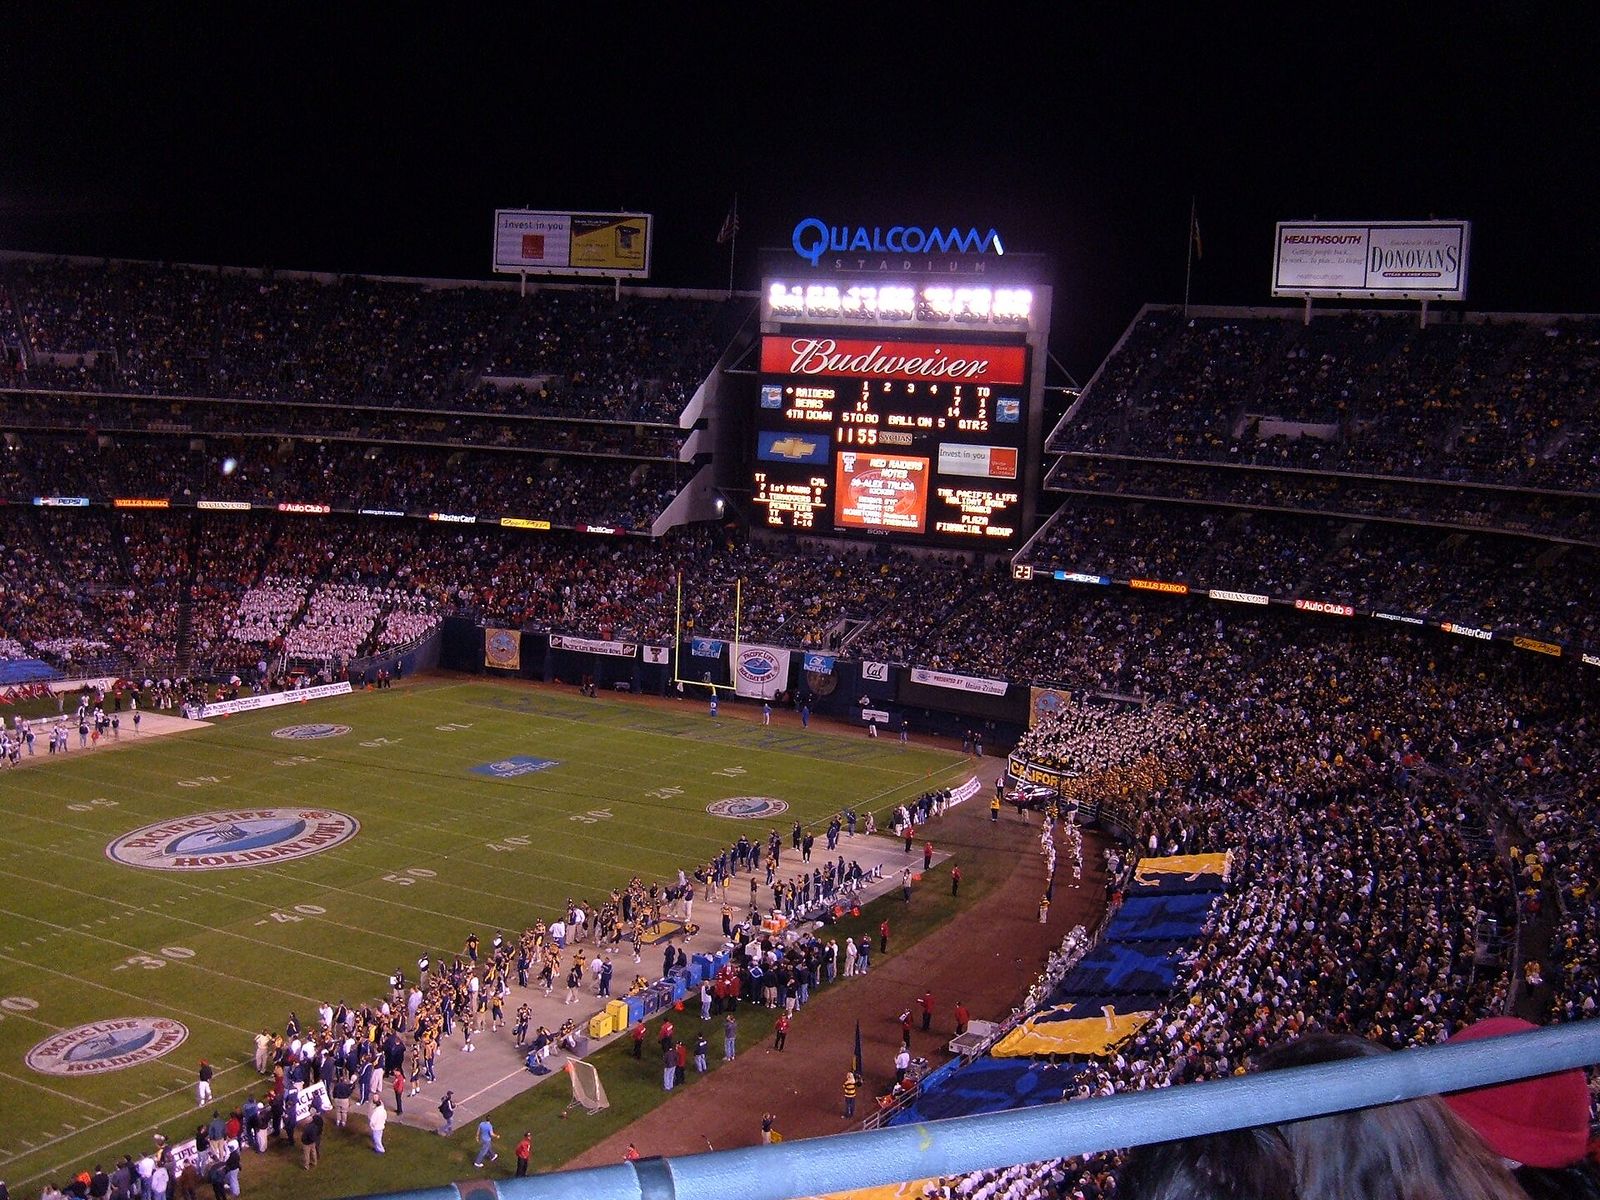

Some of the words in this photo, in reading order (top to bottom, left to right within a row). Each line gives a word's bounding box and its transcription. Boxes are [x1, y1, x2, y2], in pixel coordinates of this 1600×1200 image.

[504, 220, 532, 228] Invest
[536, 221, 544, 229] in
[548, 223, 563, 231] you
[792, 217, 1004, 267] QUALCOMM
[1284, 235, 1362, 245] HEALTHSOUTH
[835, 259, 985, 271] STADIUM
[1371, 244, 1457, 273] DONOVAN'S
[790, 339, 988, 378] Budweiser
[862, 381, 869, 391] 1
[884, 382, 892, 392] 2
[907, 383, 915, 393] 3
[930, 384, 938, 394] 4
[955, 386, 962, 395] T
[977, 387, 991, 397] TO
[796, 388, 835, 399] RAIDERS
[862, 391, 870, 401] 7
[953, 396, 961, 406] 7
[980, 398, 986, 408] 1
[856, 401, 868, 412] 14
[947, 407, 960, 417] 14
[978, 409, 987, 419] 2
[786, 409, 804, 419] 4TH
[806, 410, 833, 421] DOWN
[888, 415, 915, 426] BALL
[937, 418, 946, 428] 5
[940, 448, 961, 458] Invest
[963, 451, 971, 459] in
[973, 452, 986, 461] you
[956, 489, 993, 500] PACIFIC
[996, 493, 1018, 502] LIFE
[287, 504, 304, 512] Auto
[305, 505, 323, 513] Club
[1015, 566, 1031, 578] 23
[1074, 575, 1100, 584] PEPSI
[1131, 579, 1160, 589] WELLS
[1160, 583, 1187, 593] FARGO
[1304, 601, 1324, 612] Auto
[1324, 603, 1344, 615] Club
[1451, 624, 1493, 640] MasterCard
[743, 651, 762, 660] PACIFIC
[866, 663, 883, 679] Cal
[123, 815, 207, 849] PACIFIC
[206, 810, 276, 826] LIFE
[172, 842, 306, 868] HOLIDAY
[306, 820, 346, 850] BOWL
[486, 835, 532, 852] 40
[382, 868, 438, 886] 50
[270, 904, 327, 924] 40
[126, 946, 197, 970] 30
[37, 1028, 93, 1057] PACIFIC
[92, 1020, 139, 1035] LIFE
[66, 1049, 153, 1073] HOLIDAY
[153, 1028, 180, 1053] BOWL
